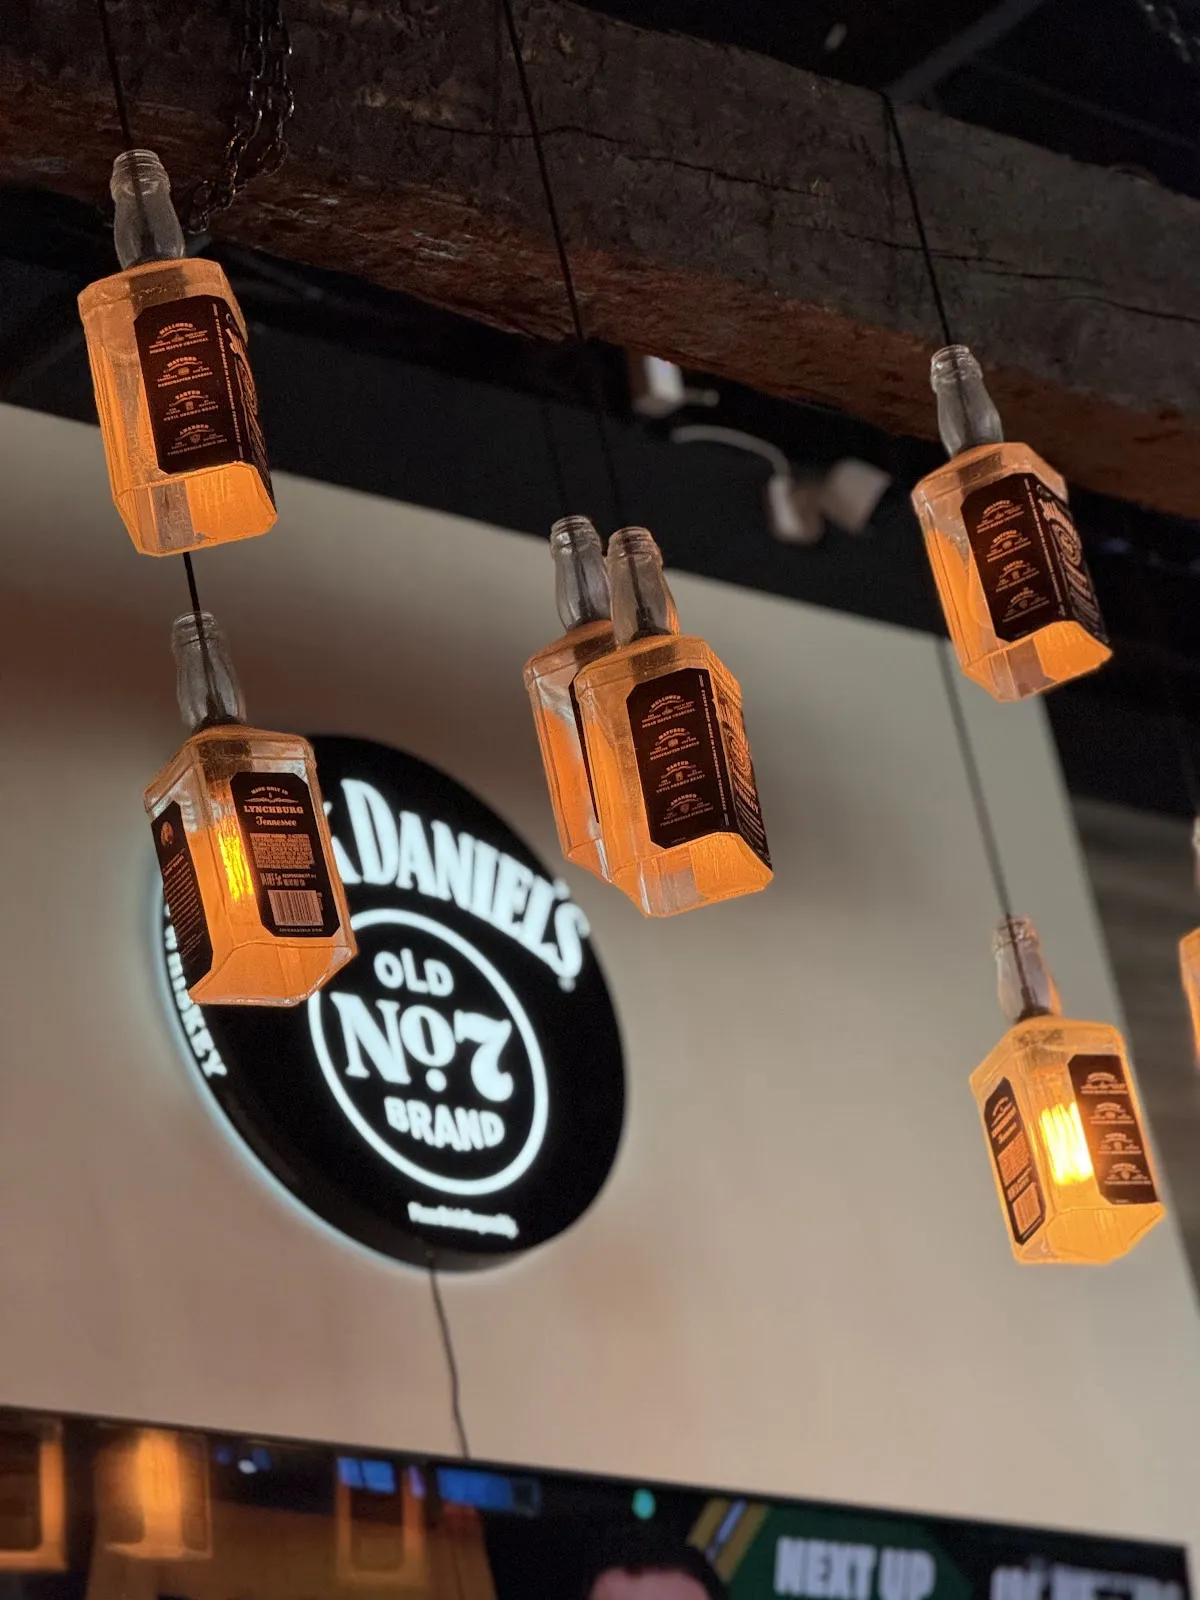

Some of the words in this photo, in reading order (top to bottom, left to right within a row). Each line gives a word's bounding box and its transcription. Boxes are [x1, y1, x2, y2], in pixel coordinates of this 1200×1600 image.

[243, 805, 305, 815] LYNCHBURG
[255, 815, 298, 827] Tennessee
[373, 947, 455, 997] OLD
[384, 1096, 506, 1152] BRAND
[774, 1535, 877, 1600] NEXT
[878, 1546, 937, 1600] UP
